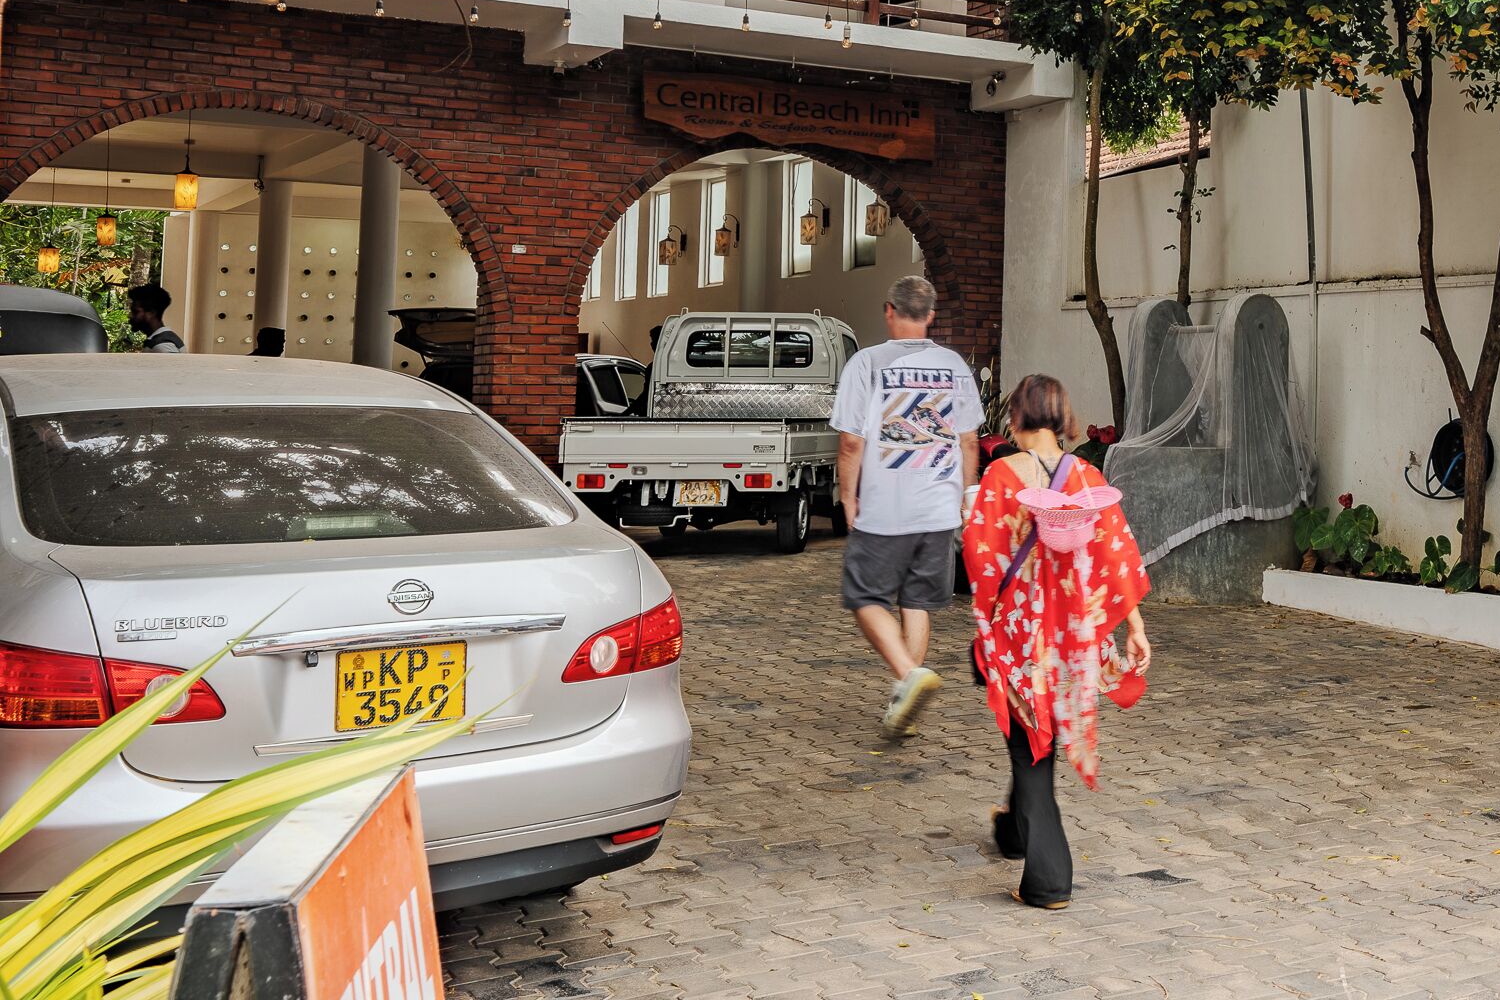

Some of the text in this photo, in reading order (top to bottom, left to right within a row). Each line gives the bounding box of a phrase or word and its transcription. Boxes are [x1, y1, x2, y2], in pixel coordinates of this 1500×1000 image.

[656, 83, 911, 127] Central Beach Inn
[684, 114, 735, 127] Rooms
[739, 118, 752, 127] &
[757, 120, 816, 133] Seafood
[393, 592, 434, 602] NISSAN
[115, 615, 228, 632] BLUEBIRD
[380, 649, 429, 686] KP
[354, 684, 449, 727] 3549
